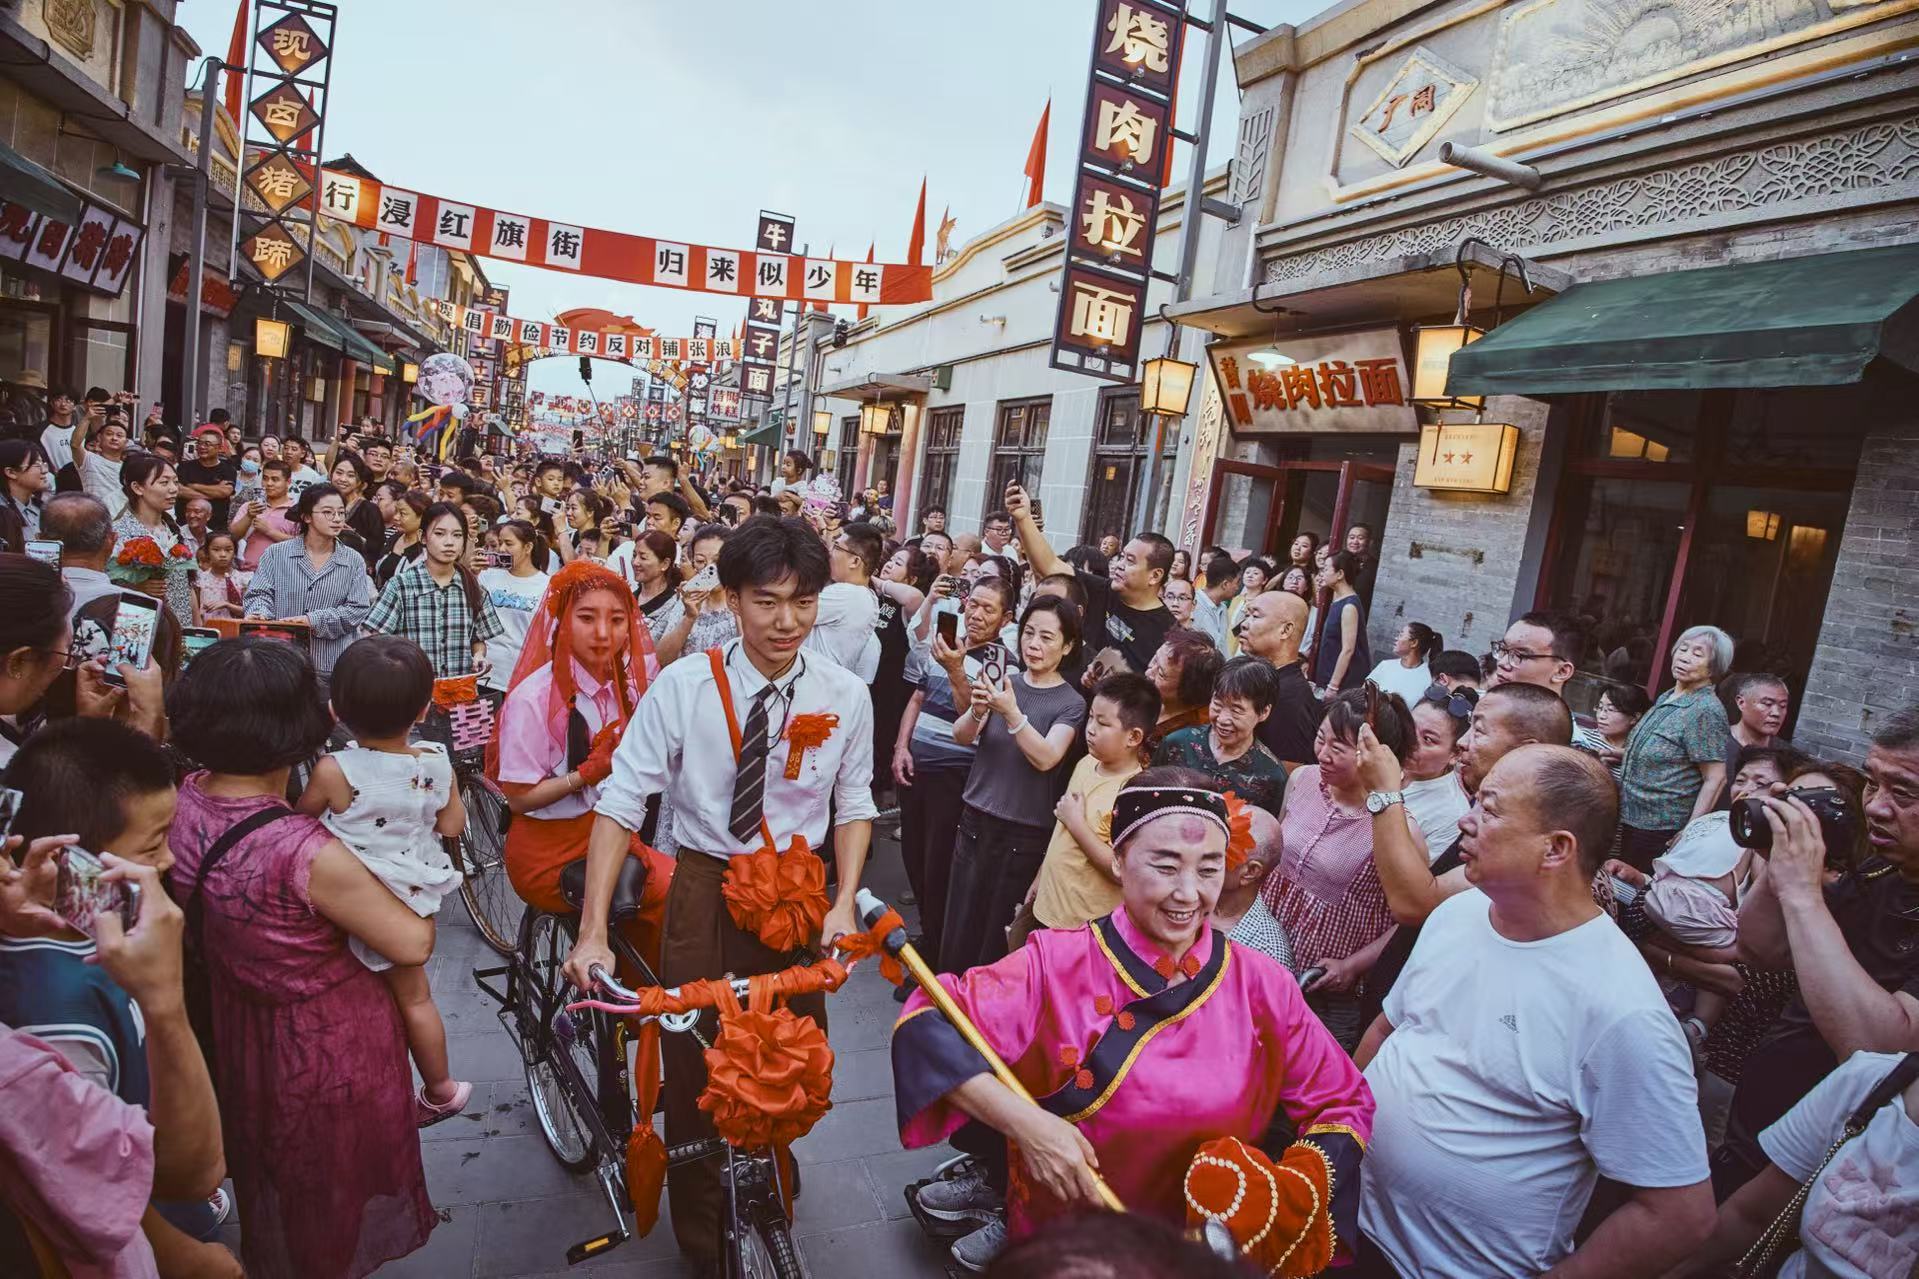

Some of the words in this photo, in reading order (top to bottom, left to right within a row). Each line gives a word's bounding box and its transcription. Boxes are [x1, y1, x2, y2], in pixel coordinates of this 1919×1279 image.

[252, 28, 311, 269] 现卤猪蹄
[1070, 2, 1169, 347] 烧肉拉面
[325, 181, 581, 259] 行浸红旗街
[658, 248, 879, 294] 归来似少年
[747, 223, 787, 392] 牛丸子面
[440, 301, 746, 357] 提倡勤俭节约反对铺张浪
